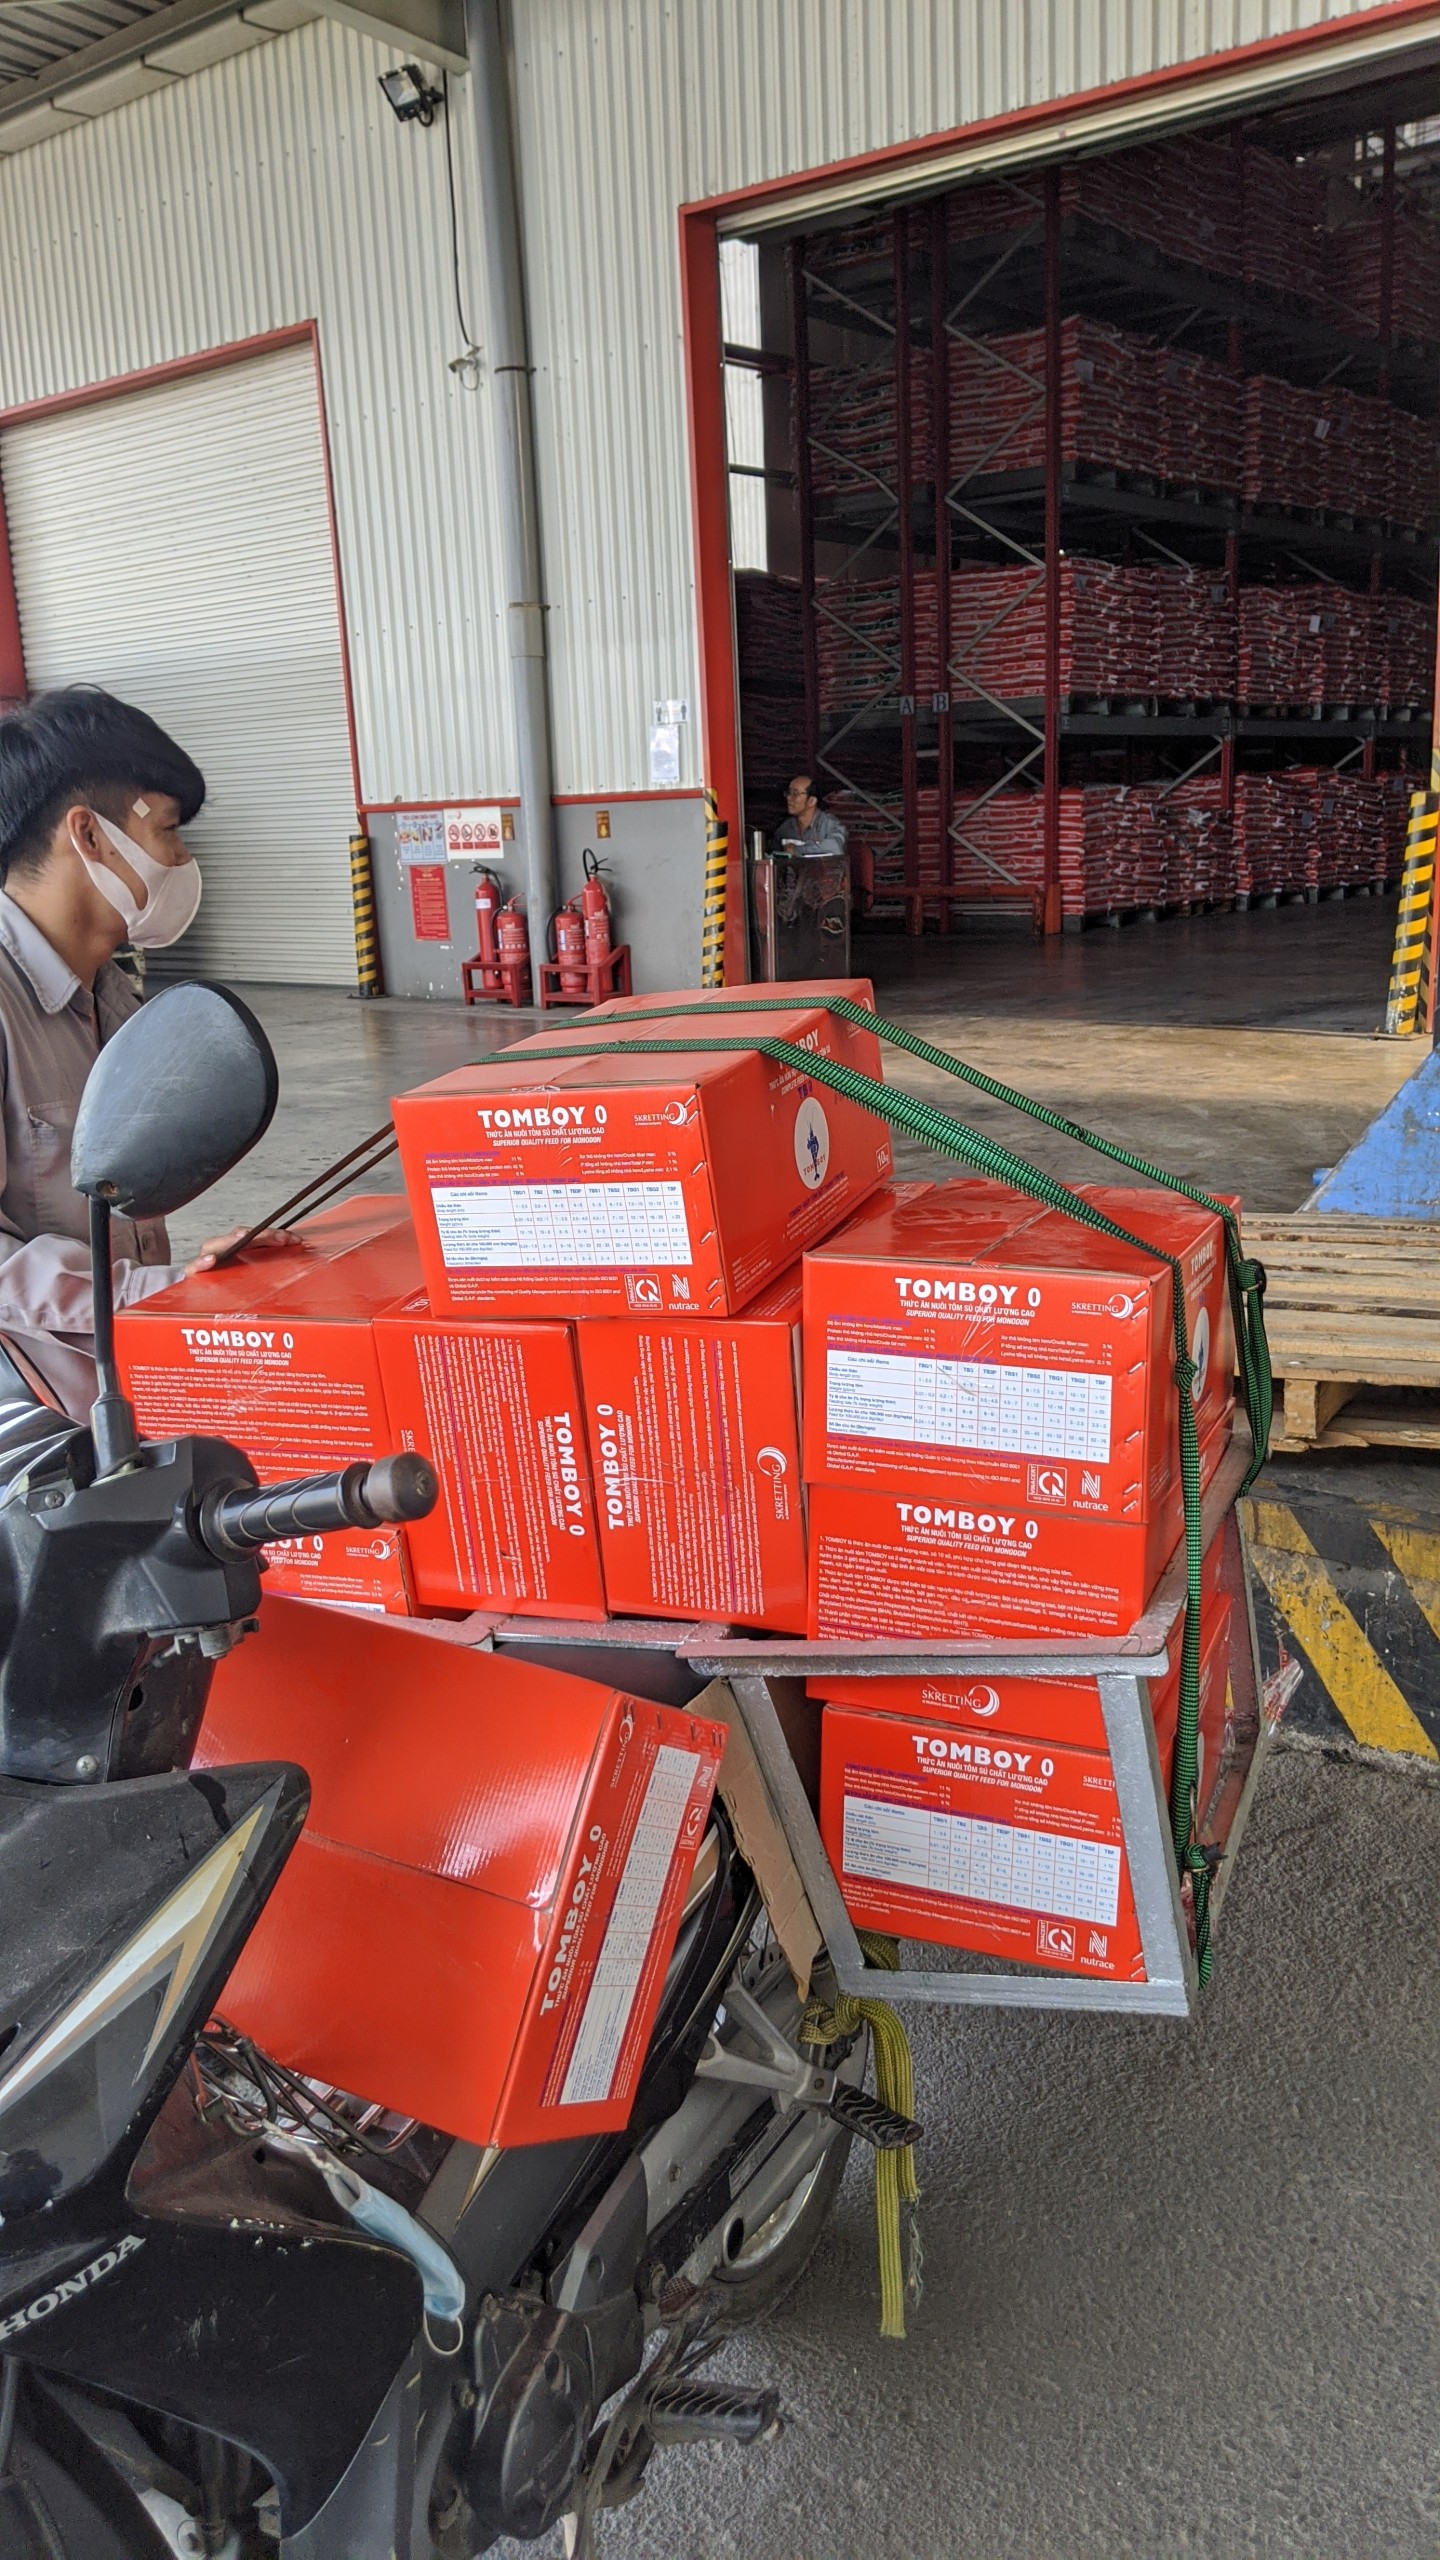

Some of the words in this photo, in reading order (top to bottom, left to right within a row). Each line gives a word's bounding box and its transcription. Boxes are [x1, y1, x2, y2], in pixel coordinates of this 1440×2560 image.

[902, 697, 911, 713] A
[936, 695, 946, 711] B
[476, 1105, 587, 1128] TOMBOY
[593, 1104, 608, 1124] 0
[633, 1113, 675, 1122] SKRETTING
[895, 1277, 1018, 1305] TOMBOY
[1027, 1286, 1040, 1308] 0
[668, 1302, 700, 1311] nutrace
[905, 1308, 936, 1318] SUPERIOR
[937, 1311, 963, 1320] QUALITY
[964, 1313, 981, 1322] FEED
[996, 1315, 1029, 1325] MONODON
[1071, 1301, 1119, 1313] SKRETTING
[180, 1328, 277, 1348] TOMBOY
[281, 1332, 294, 1349] 0
[596, 1402, 613, 1416] 0
[553, 1411, 582, 1520] TOMBOY
[568, 1523, 585, 1537] 0
[598, 1422, 624, 1529] TOMBOY
[772, 1464, 784, 1520] SKRETTING
[1072, 1500, 1109, 1512] nutrace
[896, 1502, 1015, 1536] TOMBOY
[1025, 1519, 1038, 1540] 0
[345, 1546, 380, 1555] SKRETTING
[906, 1533, 936, 1545] SUPERIOR
[936, 1538, 962, 1549] QUALITY
[963, 1542, 979, 1551] FEED
[980, 1544, 993, 1553] FOR
[993, 1546, 1026, 1558] MONODON
[922, 1689, 982, 1709] SKRETTING
[911, 1735, 1032, 1773] TOMBOY
[1039, 1756, 1054, 1777] 0
[921, 1765, 951, 1777] SUPERIOR
[952, 1771, 979, 1782] QUALITY
[979, 1775, 996, 1785] FEED
[996, 1778, 1009, 1787] FOR
[1010, 1781, 1043, 1793] MONODON
[1082, 1775, 1115, 1788] SKRETTI
[538, 1854, 595, 2016] TOMBOY
[587, 1824, 603, 1841] 0
[1080, 1957, 1115, 1970] nutrace
[0, 2234, 147, 2341] HONDA
